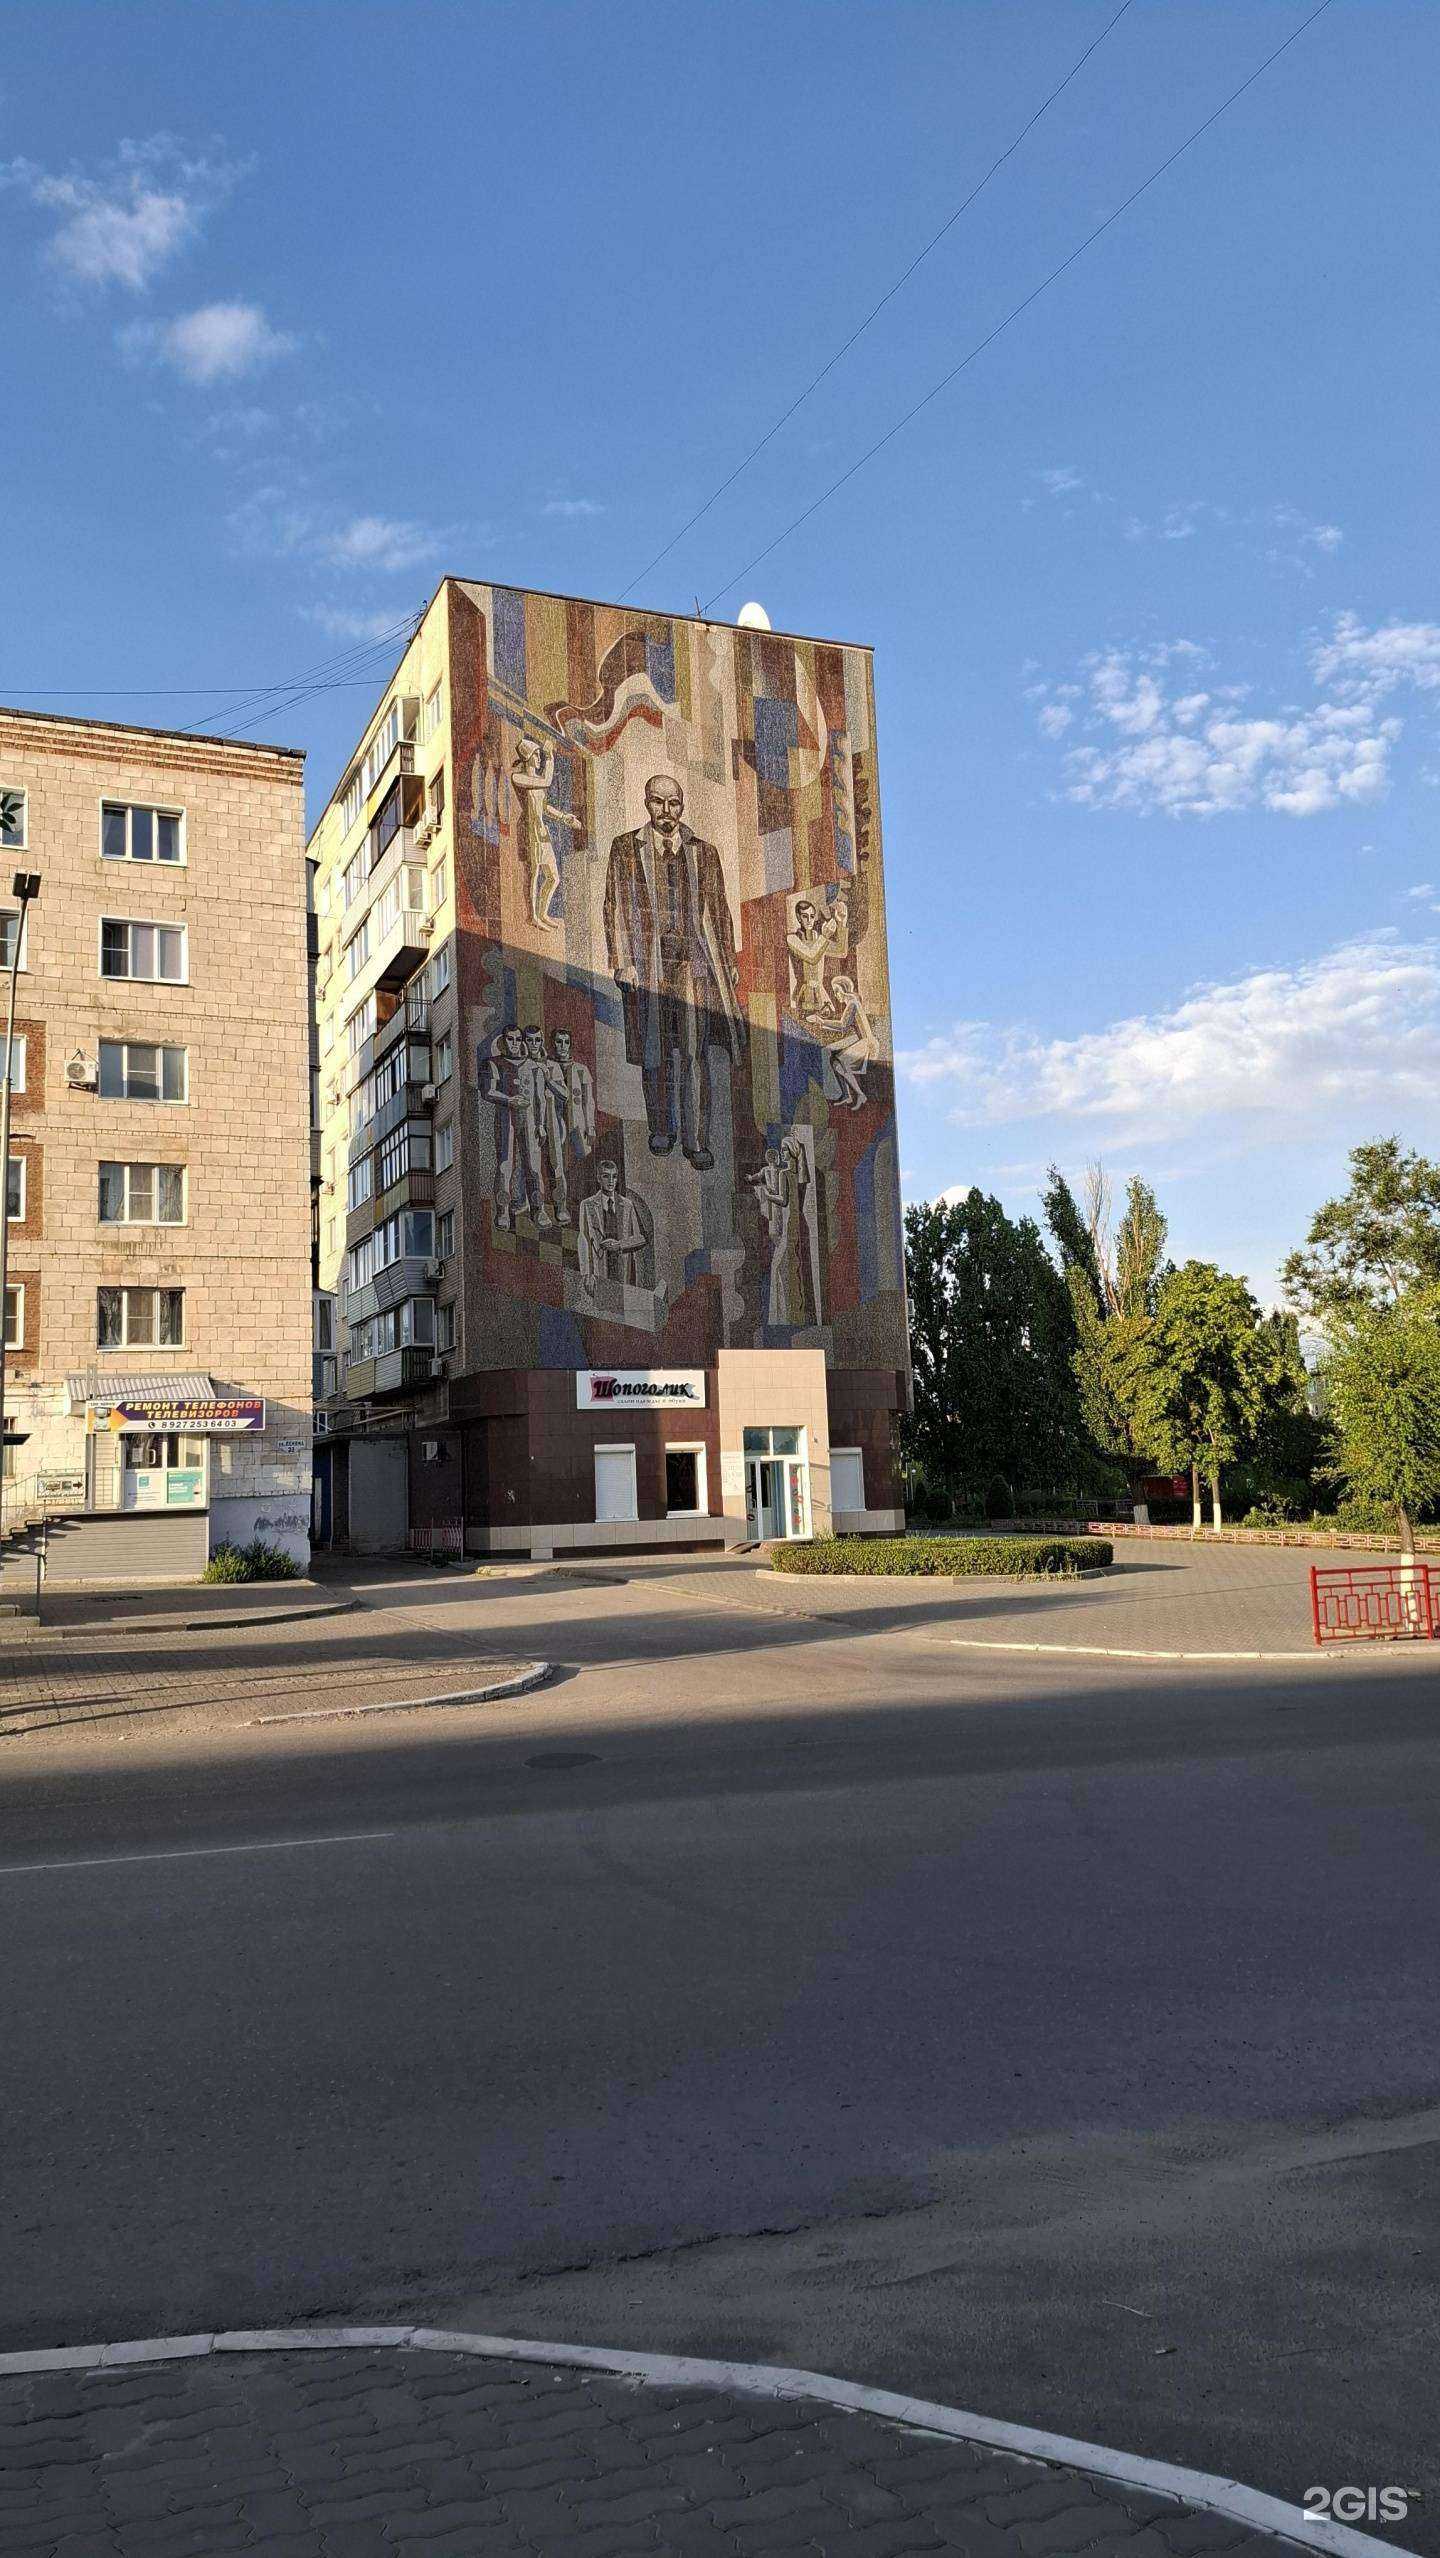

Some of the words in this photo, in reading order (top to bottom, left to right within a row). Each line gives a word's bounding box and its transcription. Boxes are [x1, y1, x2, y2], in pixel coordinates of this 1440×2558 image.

[593, 1378, 694, 1399] Шопоголик
[126, 1401, 179, 1411] РЕМОНТ
[184, 1400, 261, 1410] ТЕЛЕФОНОВ
[147, 1410, 240, 1419] ТЕЛЕВИЗОРОВ
